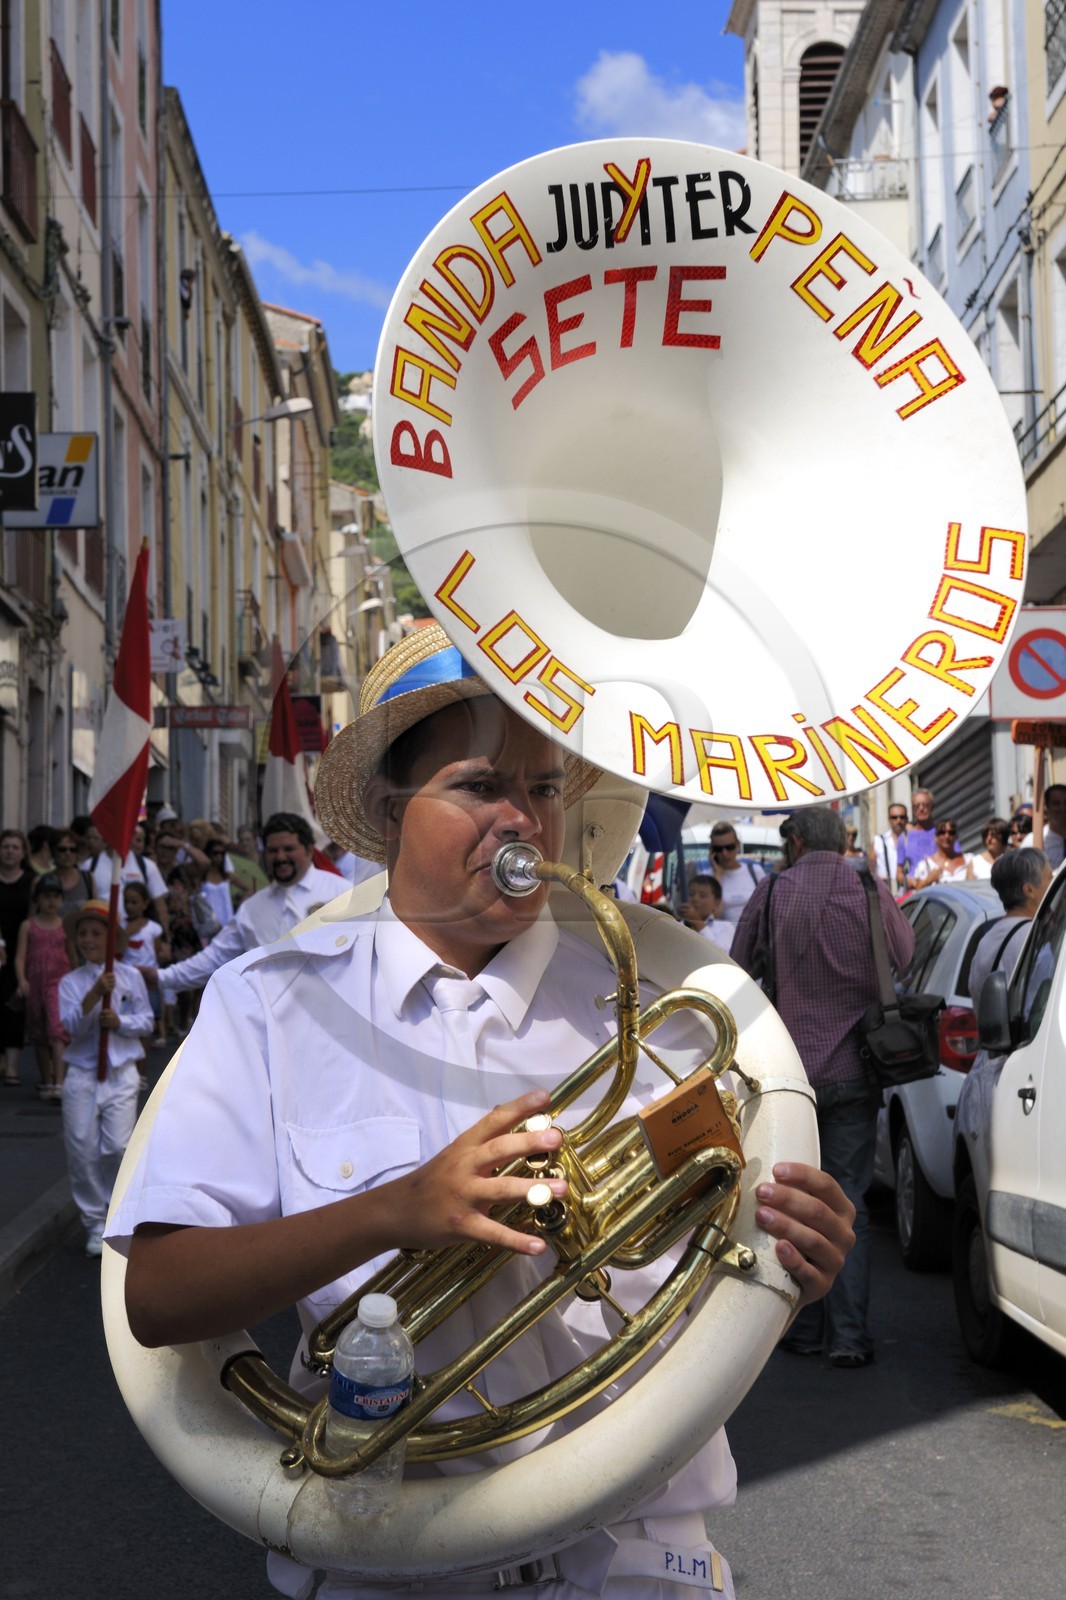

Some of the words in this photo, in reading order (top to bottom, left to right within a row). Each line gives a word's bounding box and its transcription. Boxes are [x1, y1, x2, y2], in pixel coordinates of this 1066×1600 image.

[545, 169, 758, 254] JUPITER
[390, 190, 543, 479] BANDA
[603, 157, 652, 244] Y
[748, 190, 967, 421] PEÑA
[487, 265, 727, 411] SETE
[433, 549, 596, 735] LOS
[671, 1103, 699, 1125] RHODIA
